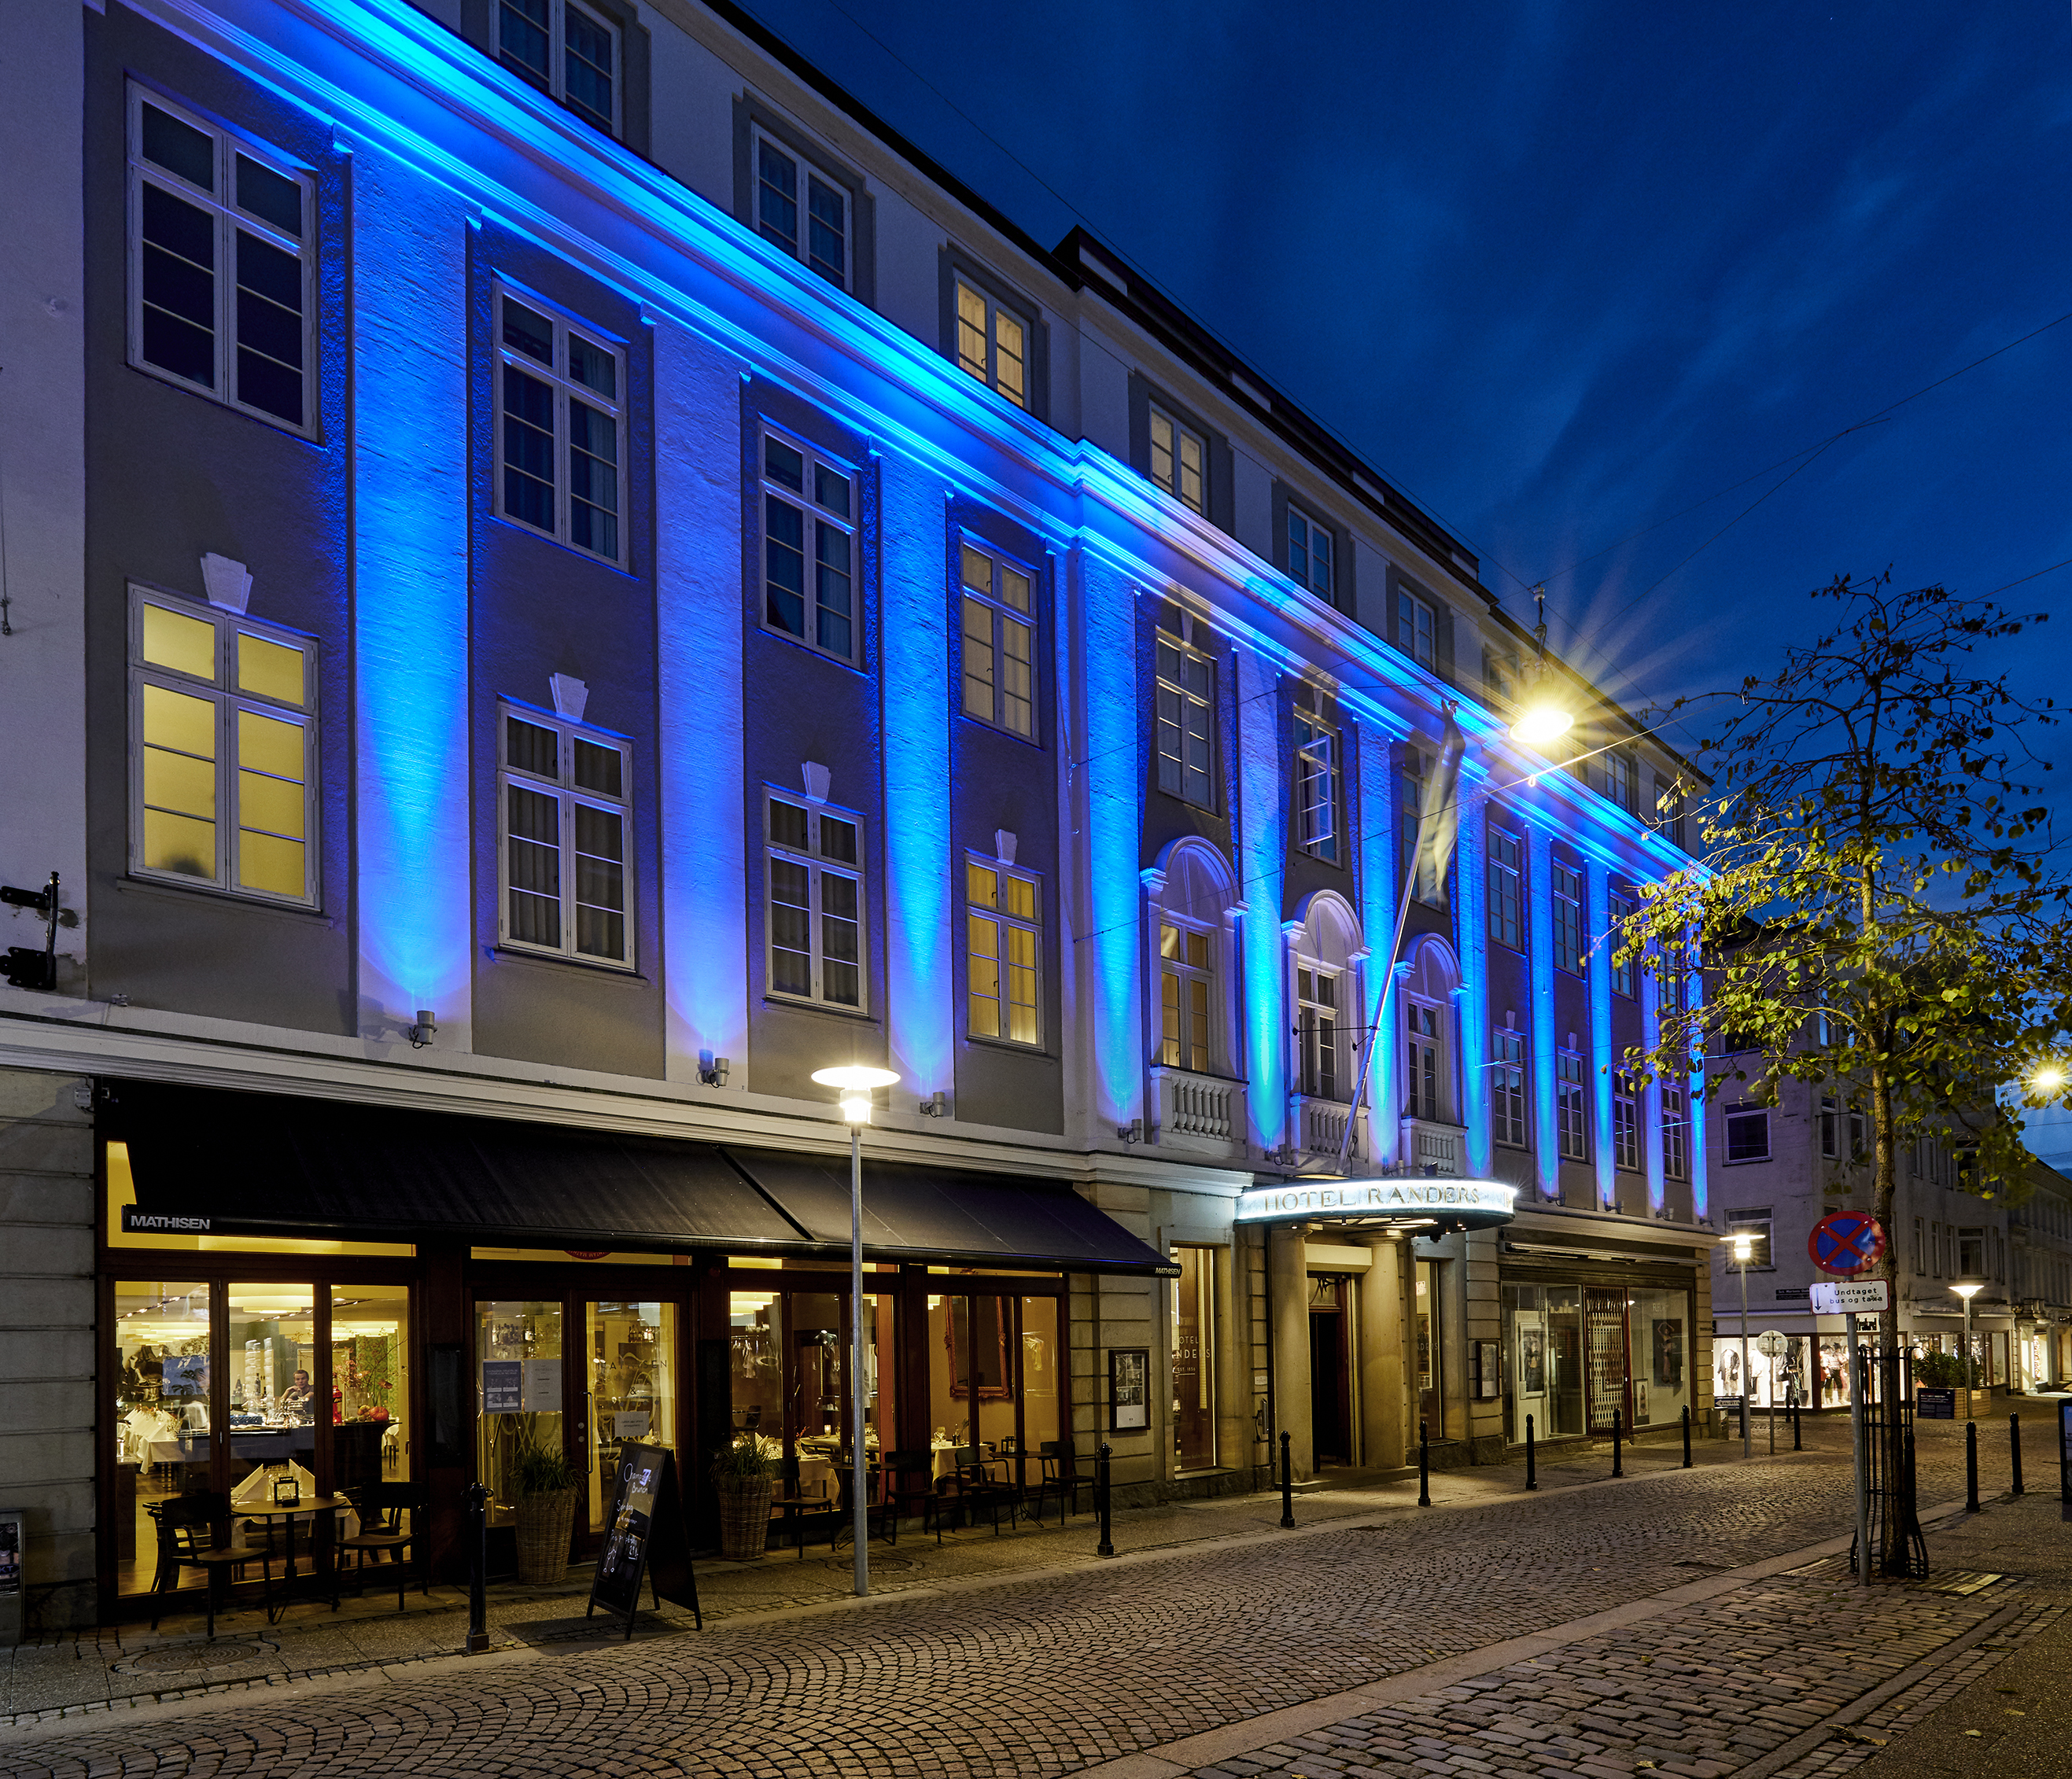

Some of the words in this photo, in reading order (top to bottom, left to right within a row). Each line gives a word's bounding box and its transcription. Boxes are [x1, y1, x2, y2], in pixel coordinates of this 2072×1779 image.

[1265, 1189, 1356, 1212] HOTEL
[1368, 1186, 1480, 1205] RANDERS
[131, 1215, 211, 1229] MATHISEN
[1834, 1287, 1877, 1296] Undtaget
[1178, 1335, 1199, 1344] OTEL
[1176, 1349, 1211, 1359] NDERS
[630, 1387, 636, 1395] &
